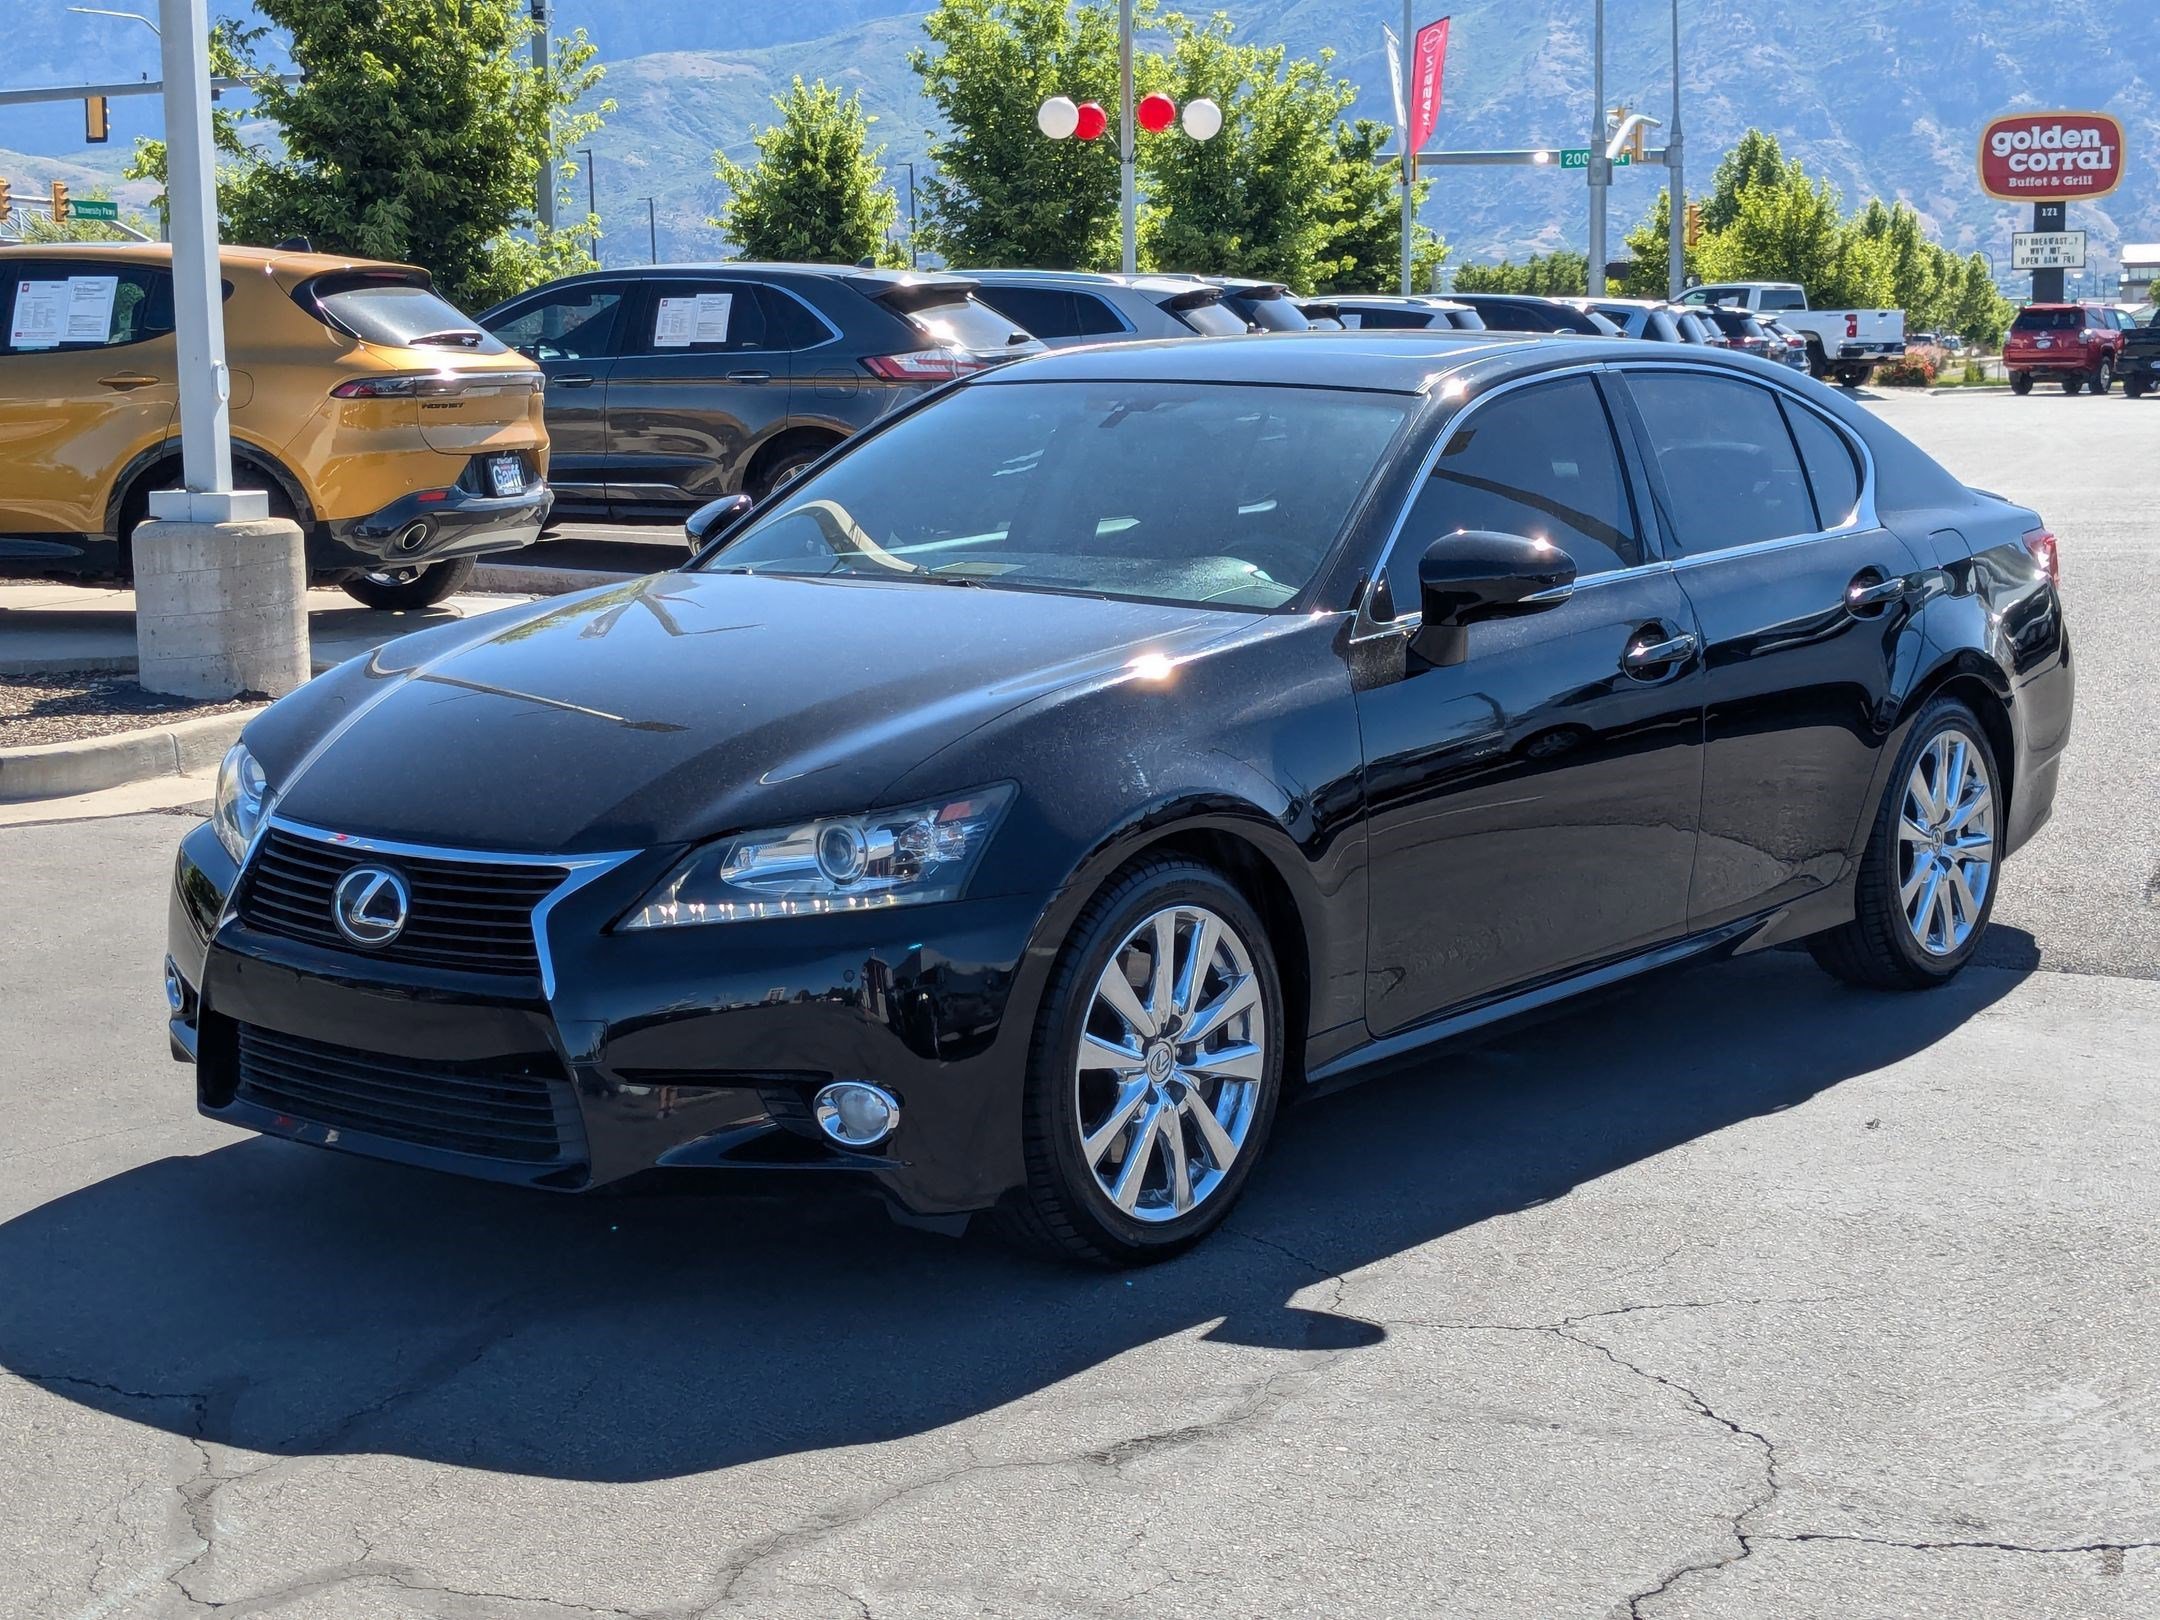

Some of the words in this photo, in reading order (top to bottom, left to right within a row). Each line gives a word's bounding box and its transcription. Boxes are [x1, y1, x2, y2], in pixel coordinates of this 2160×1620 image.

[1991, 125, 2101, 157] golden
[1565, 153, 1589, 165] 200
[2008, 146, 2112, 172] corral
[2008, 176, 2048, 187] Buffet
[2050, 177, 2060, 187] &
[2063, 175, 2093, 186] Grill
[2041, 207, 2058, 217] 171
[2020, 256, 2039, 265] OPEN
